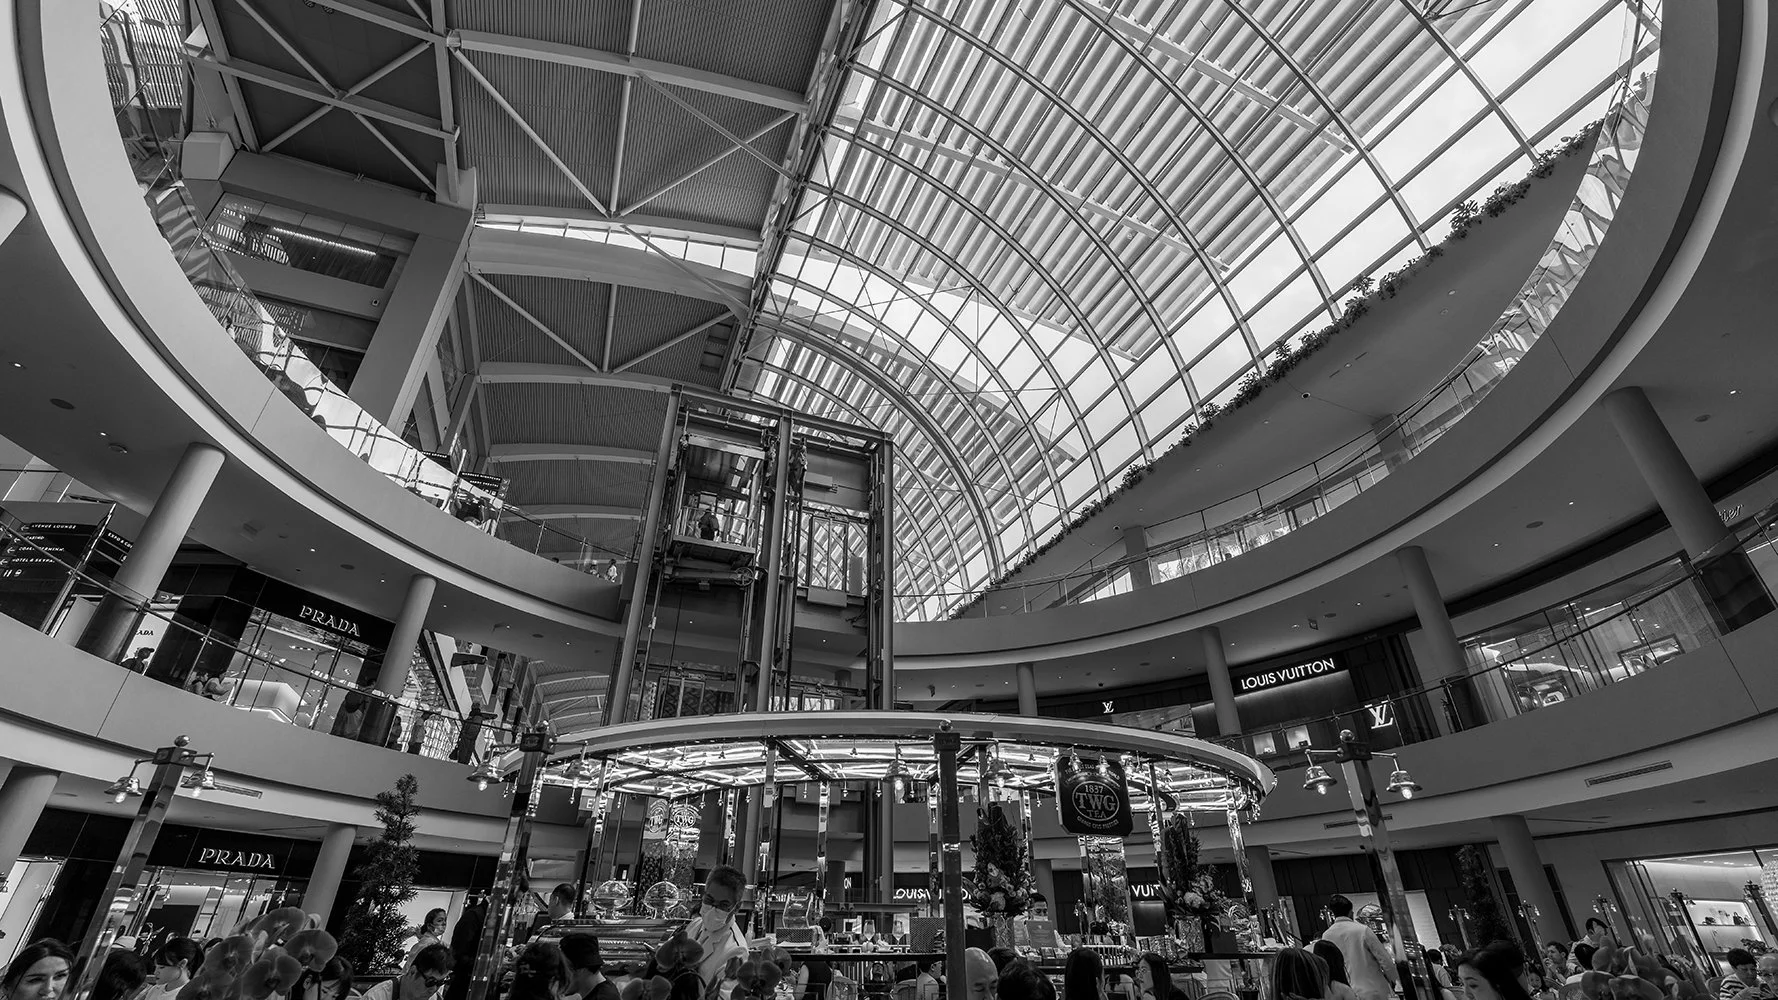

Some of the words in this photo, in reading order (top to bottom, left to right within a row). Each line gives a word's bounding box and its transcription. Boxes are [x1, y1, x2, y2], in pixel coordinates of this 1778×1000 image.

[299, 605, 360, 637] PRADA
[1241, 672, 1277, 690] LOUIS
[1276, 657, 1336, 682] VUITTON
[1084, 784, 1104, 794] 1837
[1075, 792, 1116, 811] TWG
[1087, 809, 1107, 818] TEA
[198, 847, 276, 869] PRADA
